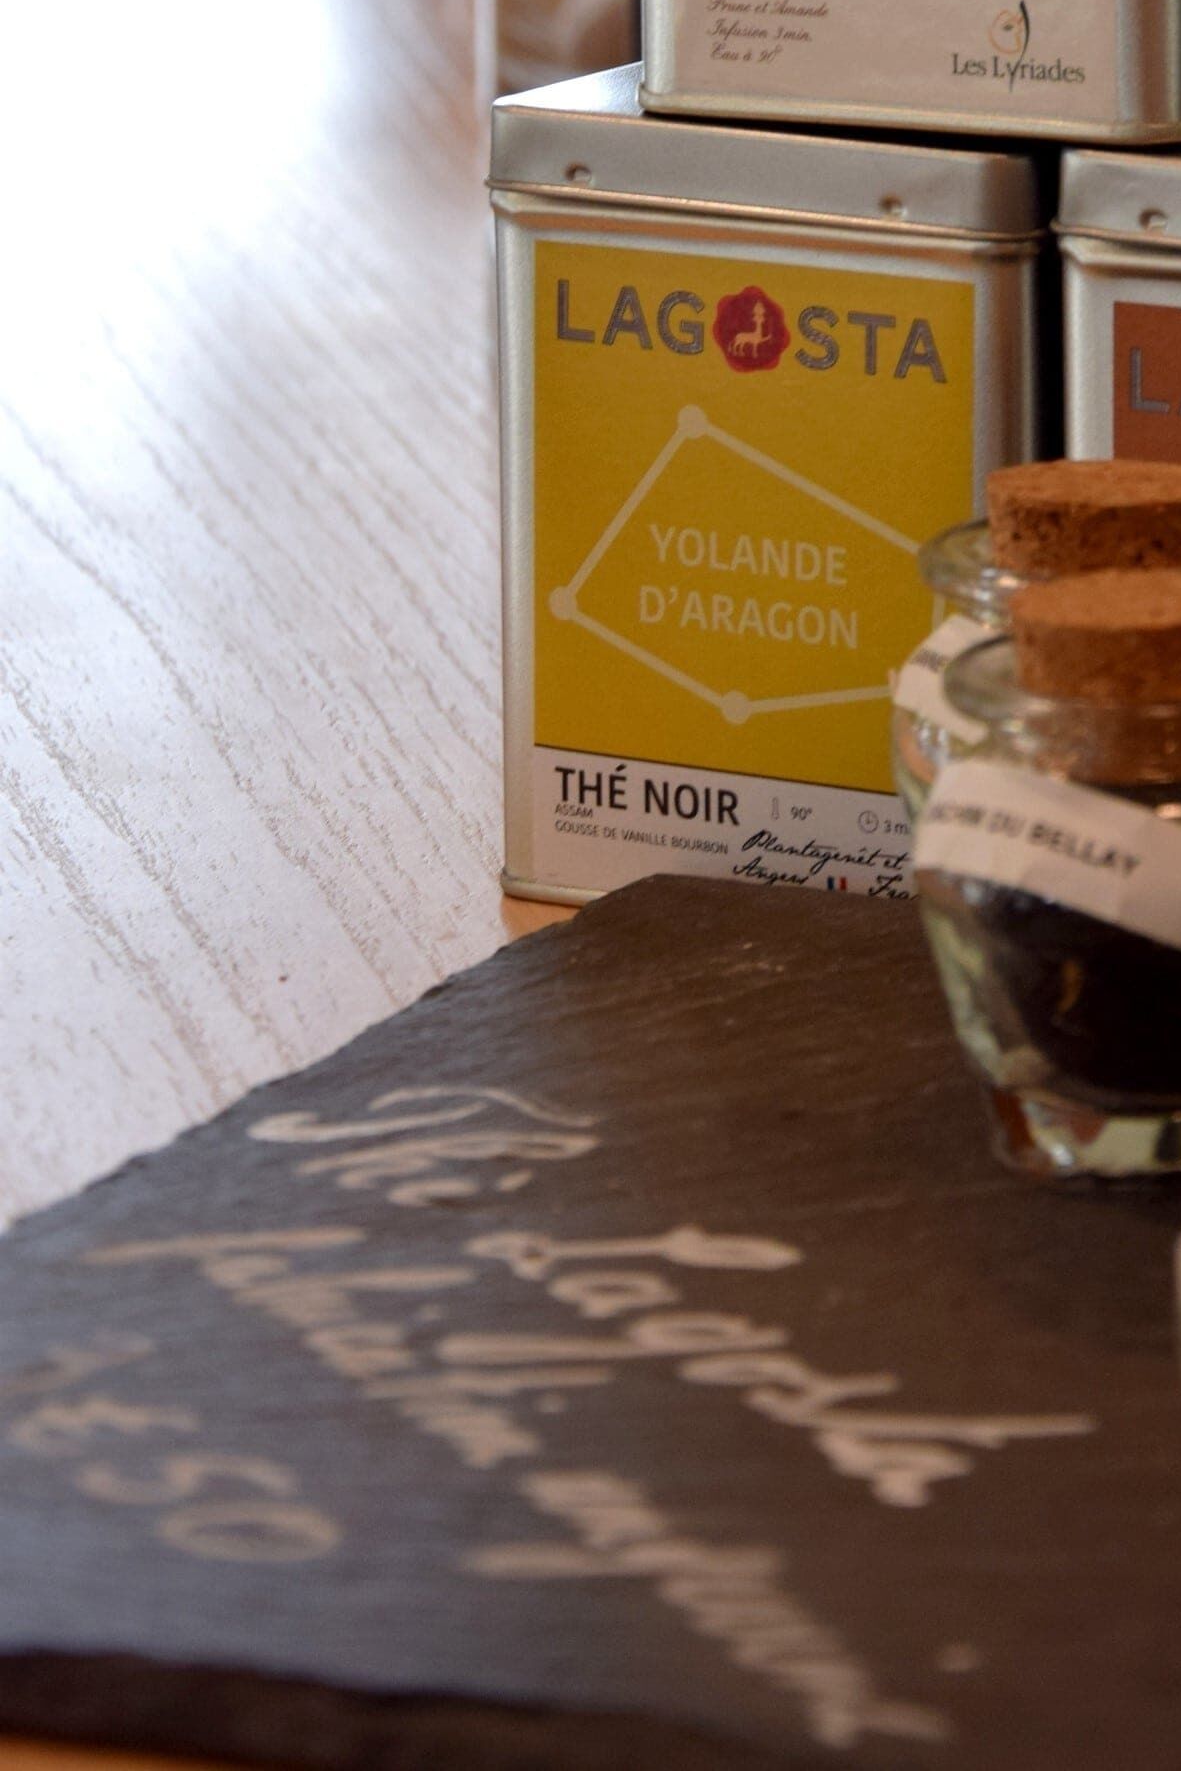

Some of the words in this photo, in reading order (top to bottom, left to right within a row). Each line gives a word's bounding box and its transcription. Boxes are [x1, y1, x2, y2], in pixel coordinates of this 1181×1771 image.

[706, 18, 768, 41] Infusion
[710, 42, 740, 61] Eau
[952, 53, 987, 77] Les
[992, 50, 1086, 94] Lyriades
[650, 524, 848, 586] YOLANDE
[639, 585, 859, 649] D'ARAGON
[554, 764, 629, 811] THÉ
[644, 779, 740, 826] NOIR
[554, 803, 594, 818] ASSAM
[791, 805, 813, 821] 90°
[554, 819, 600, 837] GOUSSE
[603, 826, 617, 840] DE
[621, 828, 669, 847] VANILLE
[671, 835, 729, 855] BOURBON
[868, 873, 920, 901] Fra
